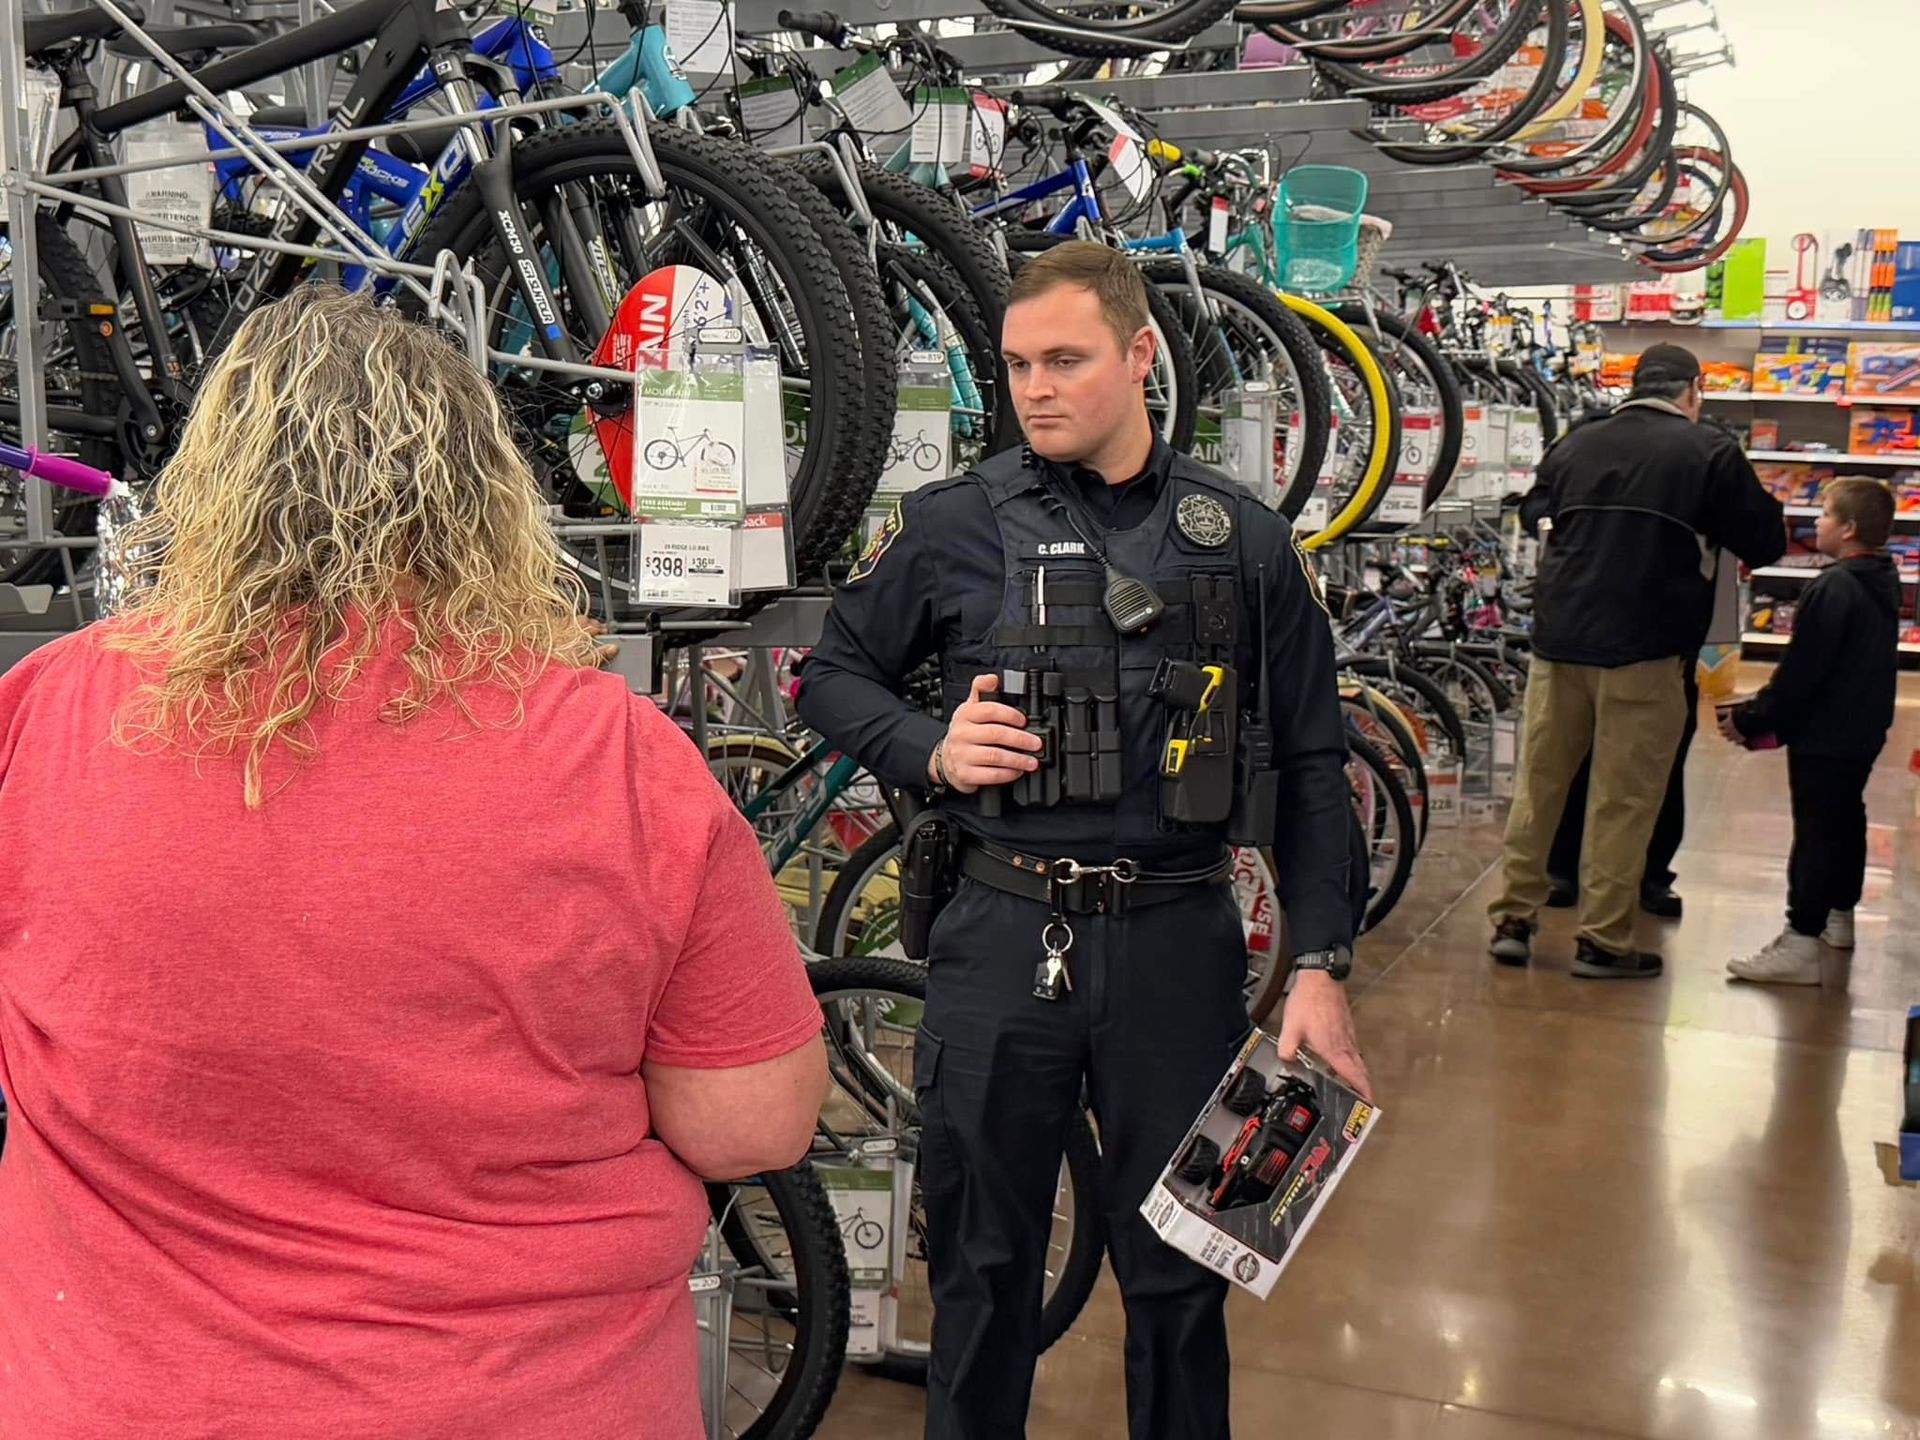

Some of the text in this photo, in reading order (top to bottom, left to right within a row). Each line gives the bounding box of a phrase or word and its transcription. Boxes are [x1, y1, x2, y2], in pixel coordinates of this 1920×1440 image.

[497, 210, 524, 254] XCM30
[529, 278, 555, 324] SUNTOUR
[1050, 541, 1085, 555] CLARK
[645, 556, 683, 577] $398
